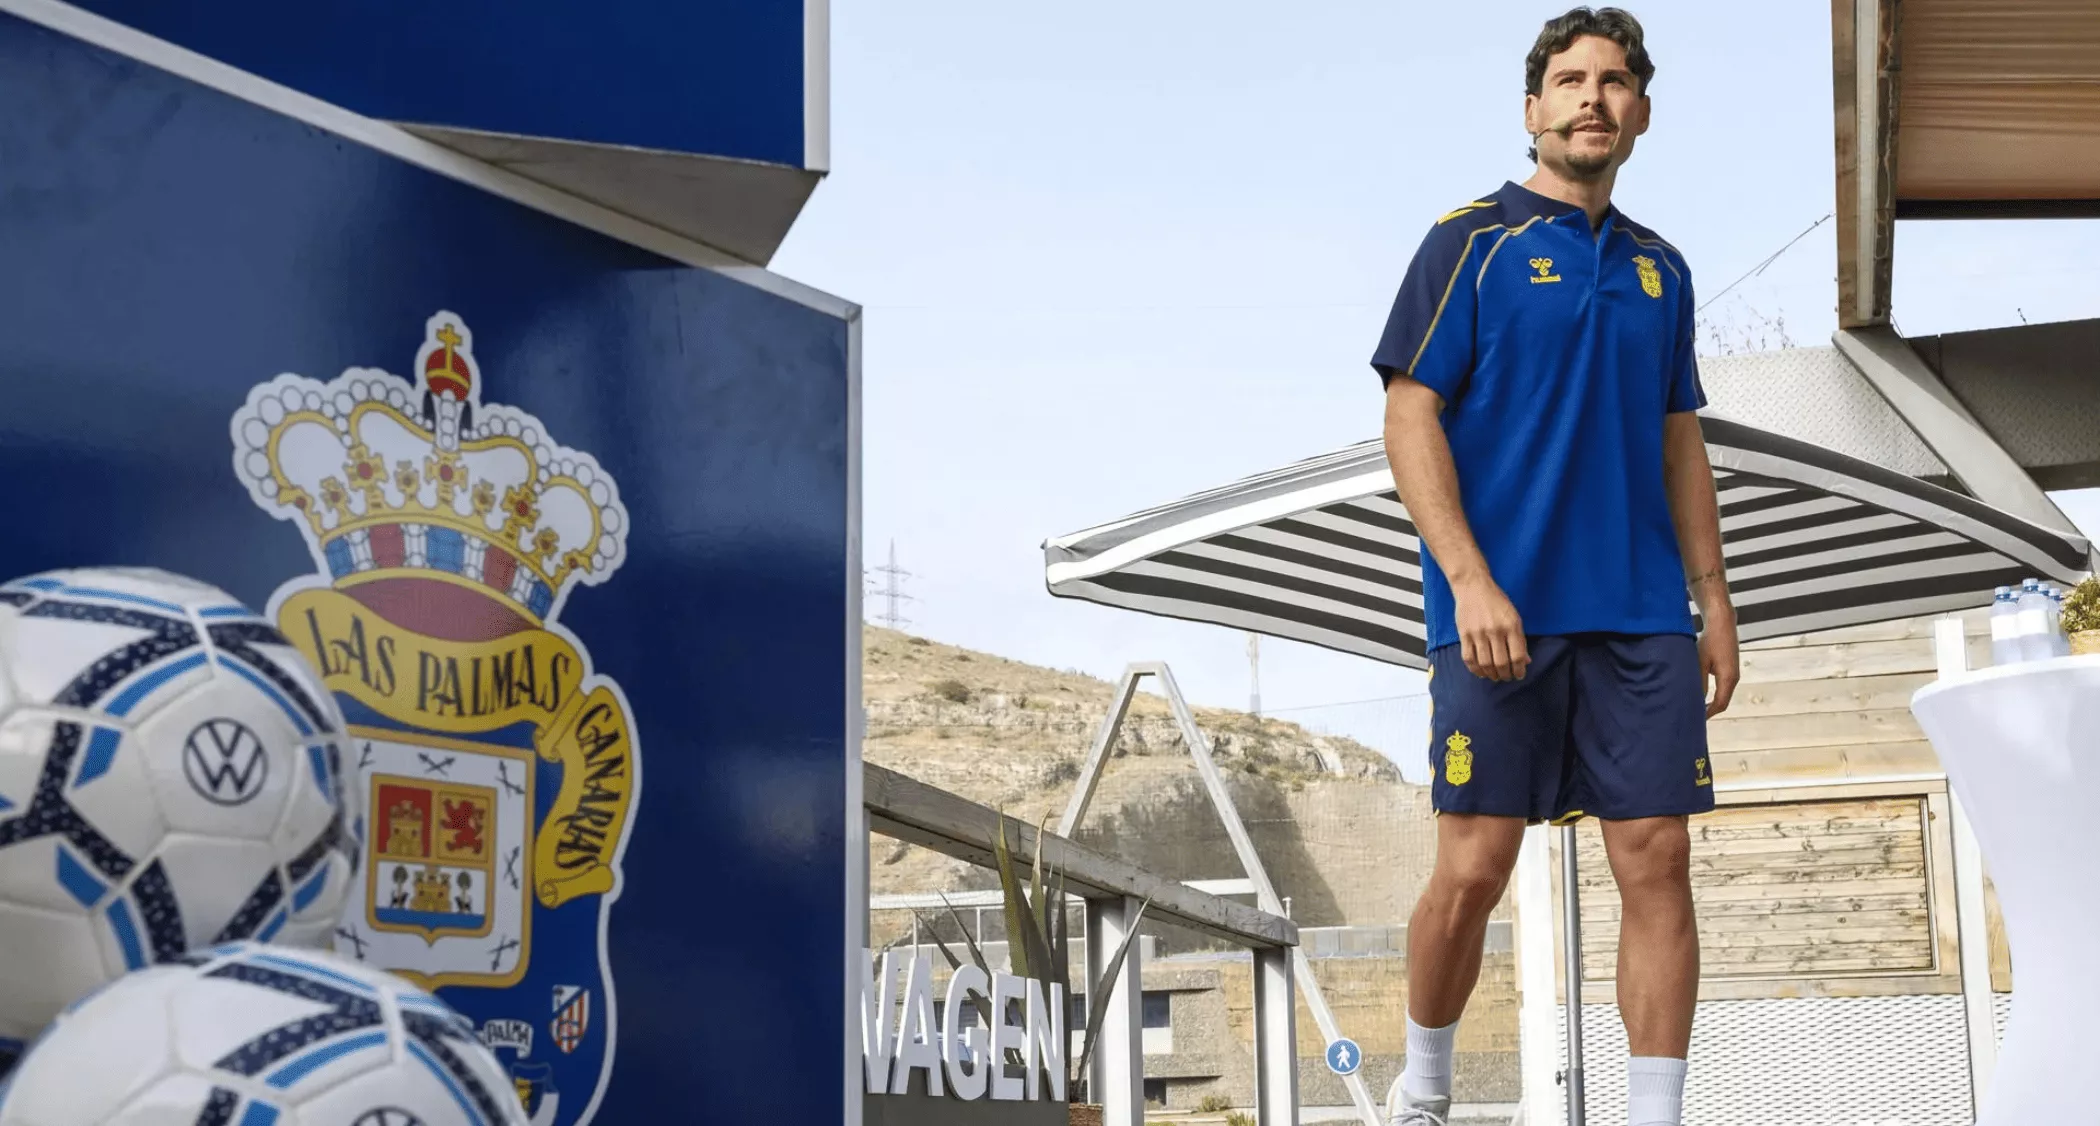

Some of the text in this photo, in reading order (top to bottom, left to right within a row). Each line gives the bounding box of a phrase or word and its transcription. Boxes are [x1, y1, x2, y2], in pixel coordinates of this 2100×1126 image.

[305, 608, 626, 871] LAS PALMAS CANARIAS
